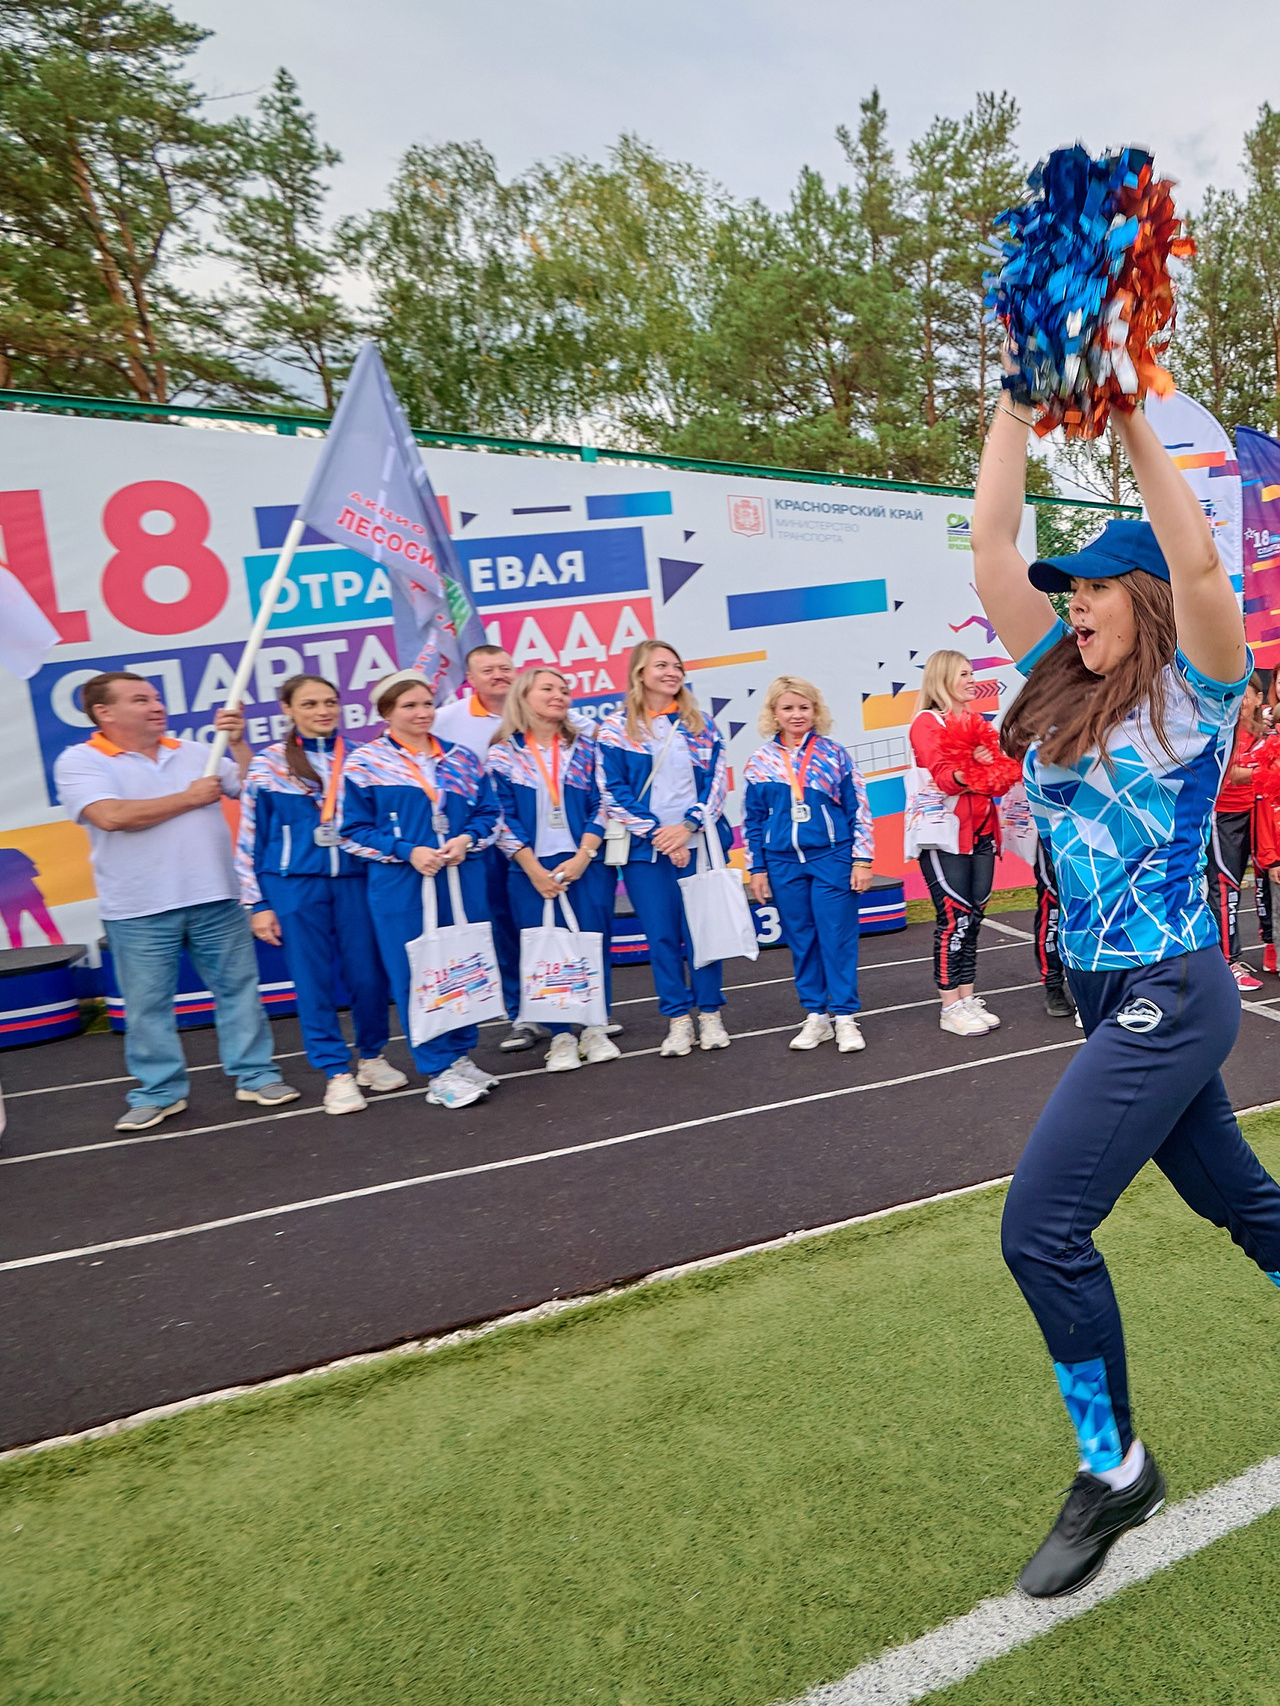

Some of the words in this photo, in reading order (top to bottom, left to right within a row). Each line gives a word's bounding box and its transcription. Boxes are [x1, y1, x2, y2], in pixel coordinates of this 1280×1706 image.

[349, 491, 427, 534] АКЦИО
[774, 498, 886, 519] КРАСНОЯРСКИЙ
[889, 507, 924, 522] КРАЙ
[775, 518, 860, 533] МИНИСТЕРСТВО
[777, 530, 844, 544] ТРАНСПОРТА
[336, 507, 440, 576] ЛЕСОСИ
[1253, 529, 1270, 548] 18
[0, 479, 229, 646] 18
[754, 906, 782, 944] 3
[544, 963, 561, 976] 18
